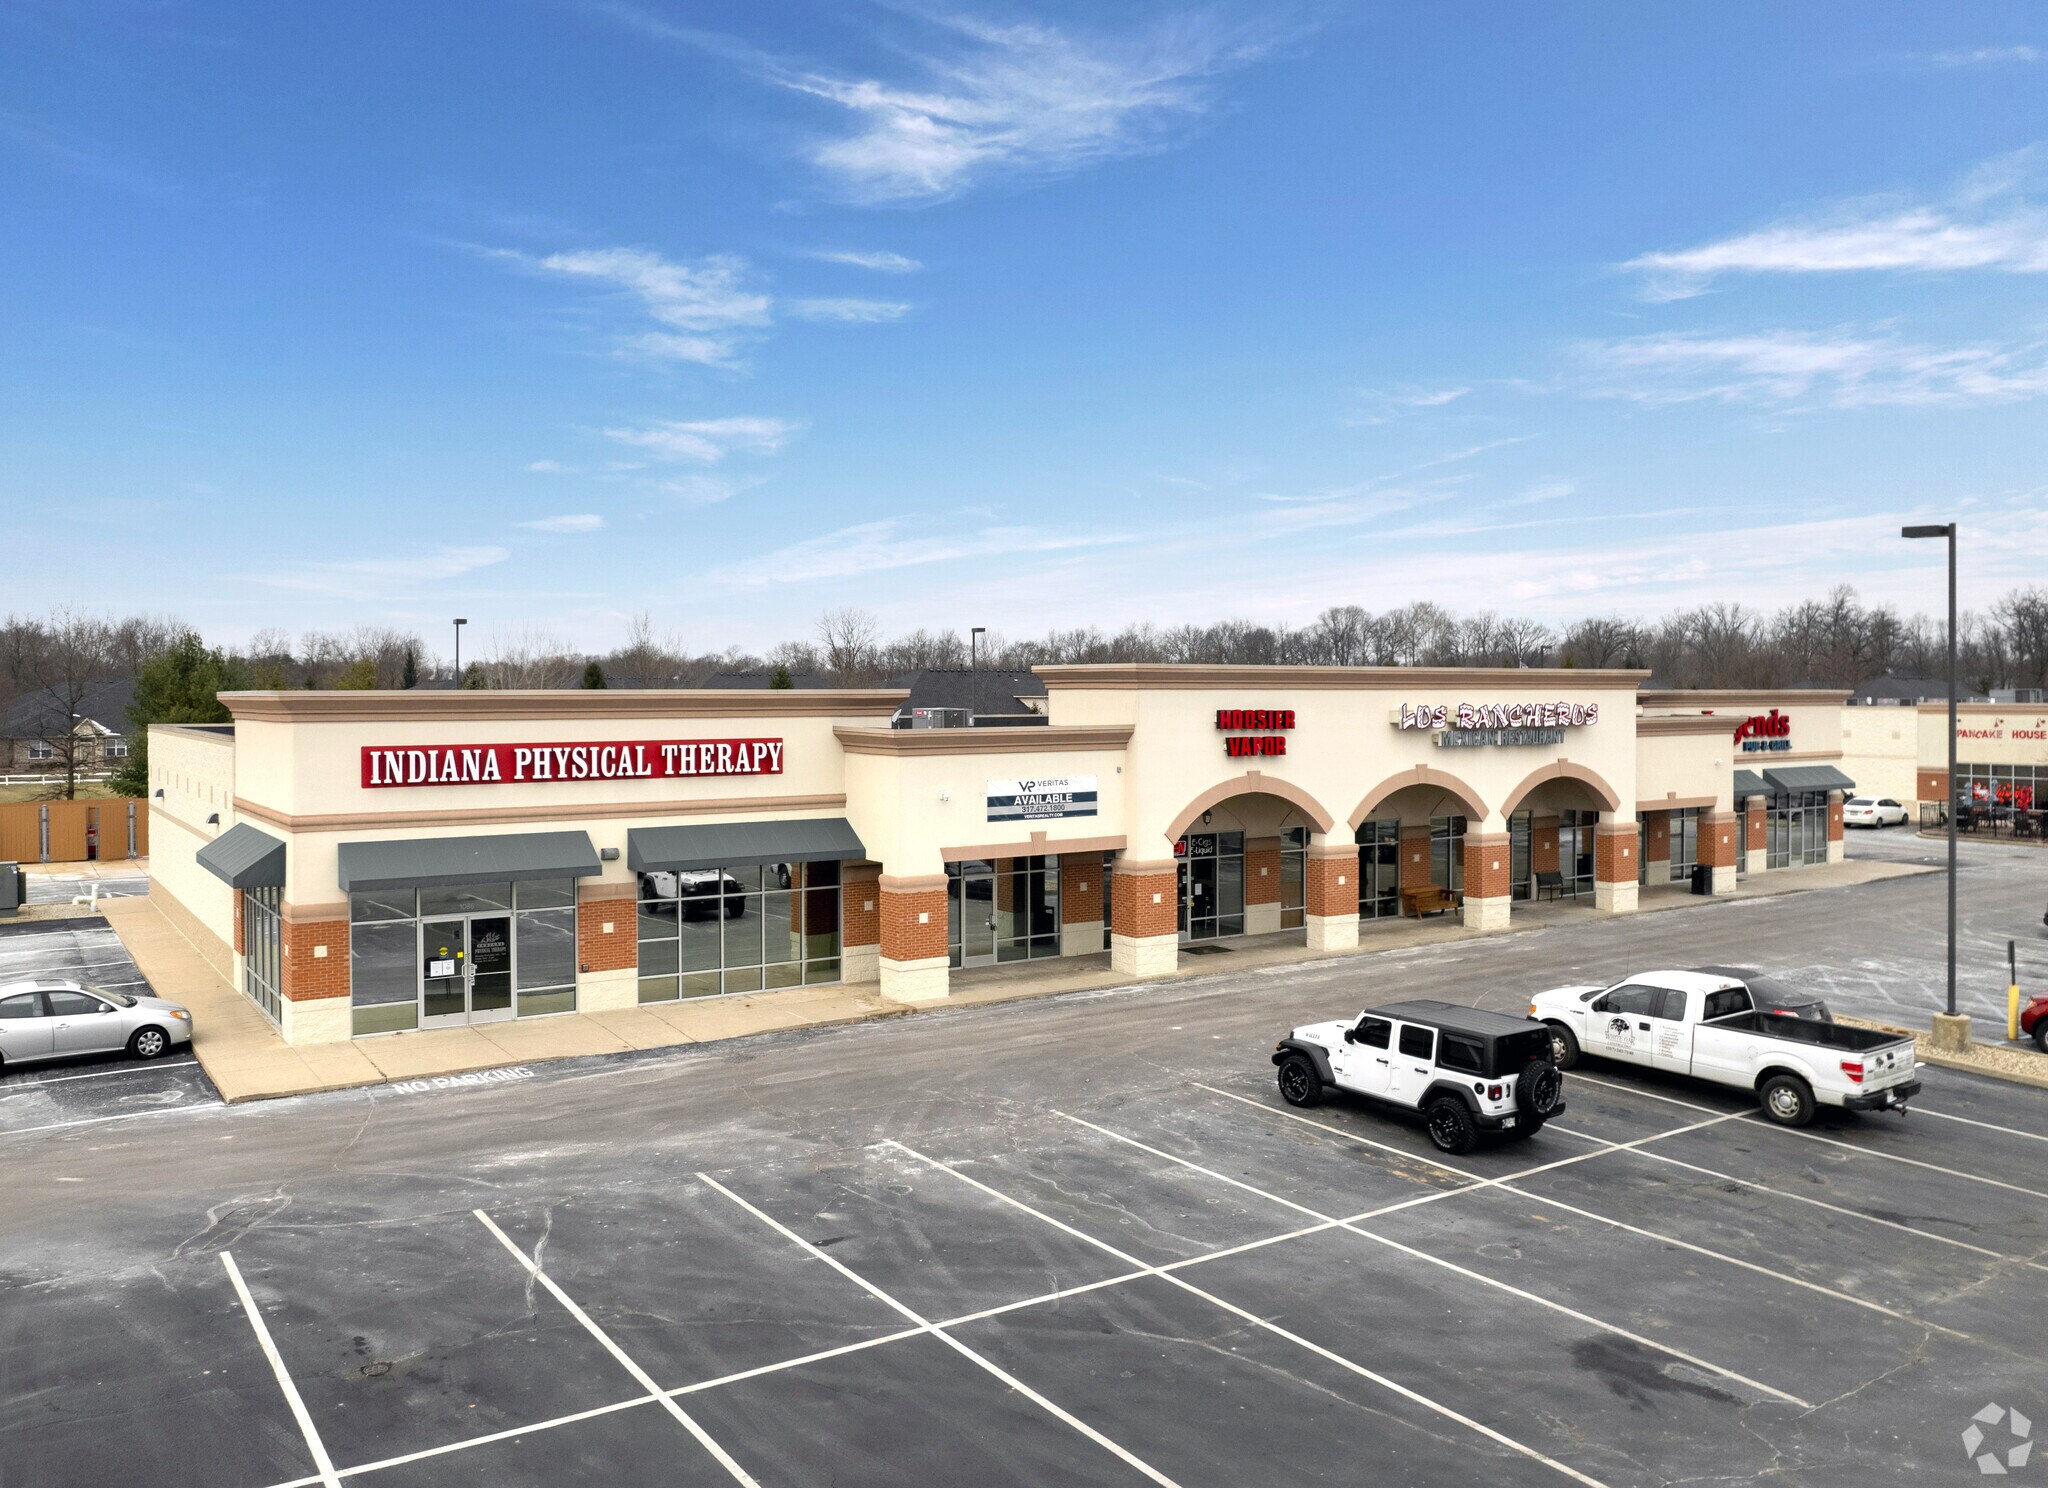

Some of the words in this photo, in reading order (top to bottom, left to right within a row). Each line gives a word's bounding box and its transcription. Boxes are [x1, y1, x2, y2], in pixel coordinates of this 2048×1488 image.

[1217, 709, 1295, 729] HOOSIER
[1401, 702, 1448, 730] LOS
[1459, 701, 1599, 730] RANCHEROS
[1440, 730, 1497, 746] MEXICAN
[1499, 729, 1566, 746] RESTAURANT
[1957, 729, 2003, 739] PANCAKE
[2012, 730, 2047, 740] HOUSE
[1226, 736, 1286, 757] VAPOR
[370, 748, 501, 785] INDIANA
[513, 745, 652, 781] PHYSICAL
[661, 742, 783, 775] THERAPY
[1014, 793, 1073, 806] AVAILABLE
[1022, 804, 1065, 813] 317.472.1800
[392, 1081, 430, 1095] NO
[432, 1067, 535, 1089] PARKING
